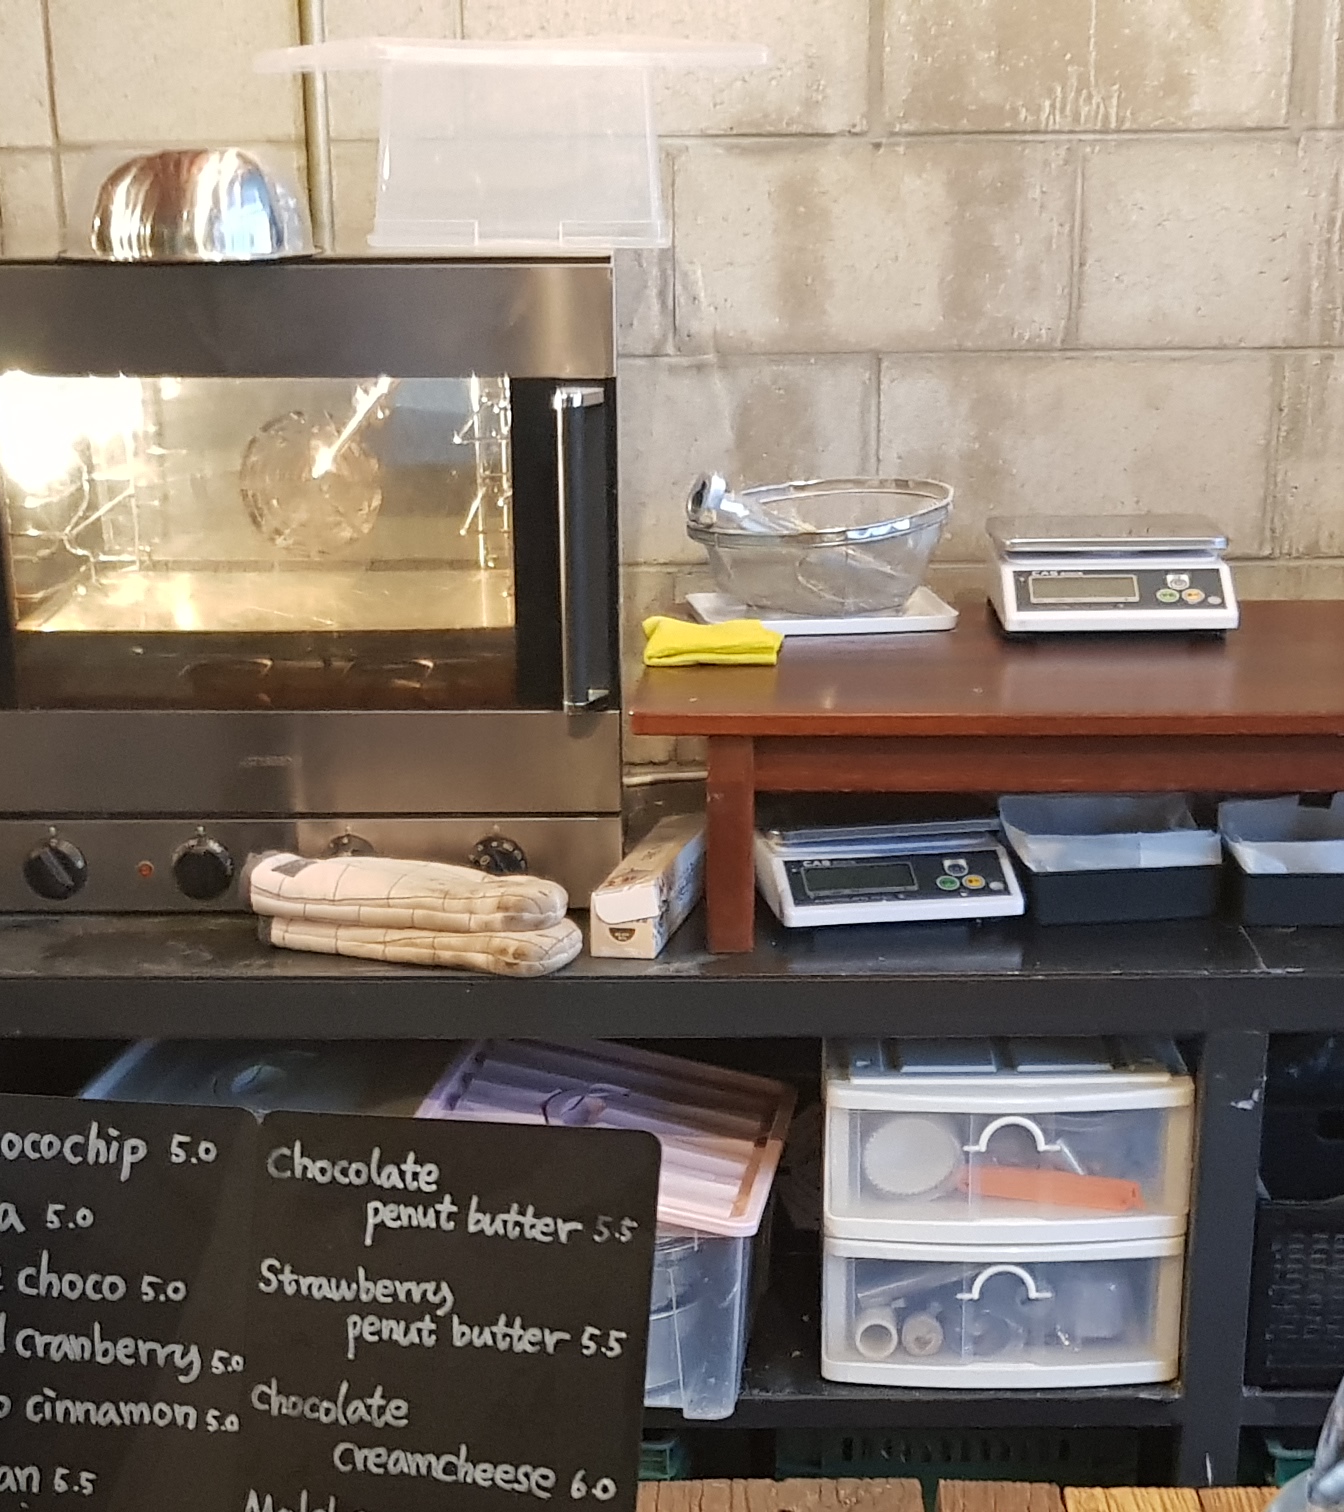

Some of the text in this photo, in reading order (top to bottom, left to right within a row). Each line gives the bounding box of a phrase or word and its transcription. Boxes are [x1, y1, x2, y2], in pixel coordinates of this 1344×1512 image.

[170, 1133, 217, 1164] 5.0
[46, 1203, 94, 1230] 5.0
[364, 1194, 639, 1247] penut butter 5.5
[18, 1249, 126, 1300] choco
[141, 1275, 187, 1302] 5.0
[259, 1257, 454, 1317] Strawberry
[15, 1321, 201, 1384] cranberry
[211, 1350, 245, 1375] 5.0
[347, 1314, 437, 1360] penut
[452, 1313, 571, 1354] butter
[26, 1387, 198, 1430] cinnamon
[206, 1409, 239, 1432] 5.0
[570, 1469, 617, 1500] 6.0
